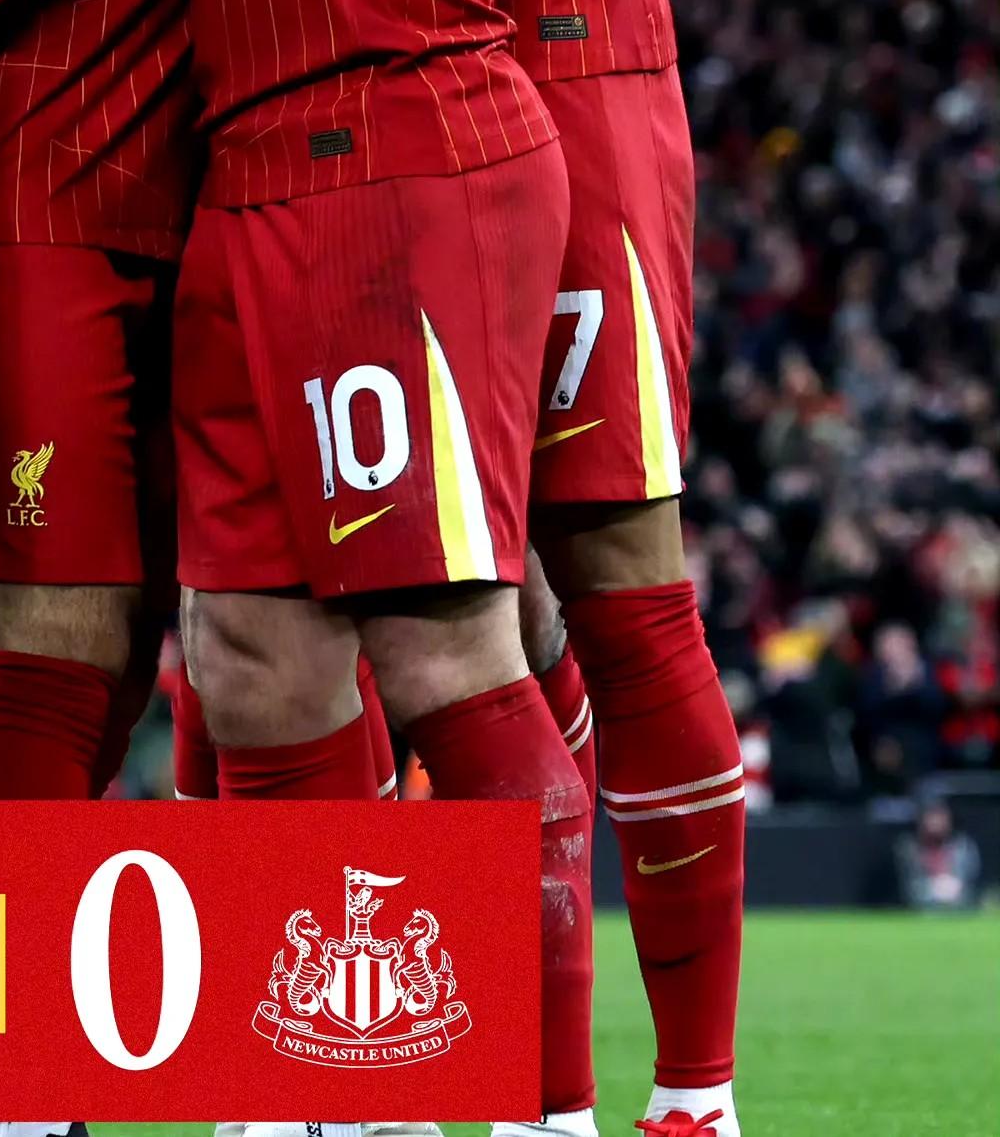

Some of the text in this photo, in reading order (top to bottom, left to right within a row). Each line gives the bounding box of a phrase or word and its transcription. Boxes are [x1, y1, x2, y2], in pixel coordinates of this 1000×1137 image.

[548, 289, 604, 410] 7
[303, 364, 410, 500] 10
[6, 508, 48, 527] L.F.C.
